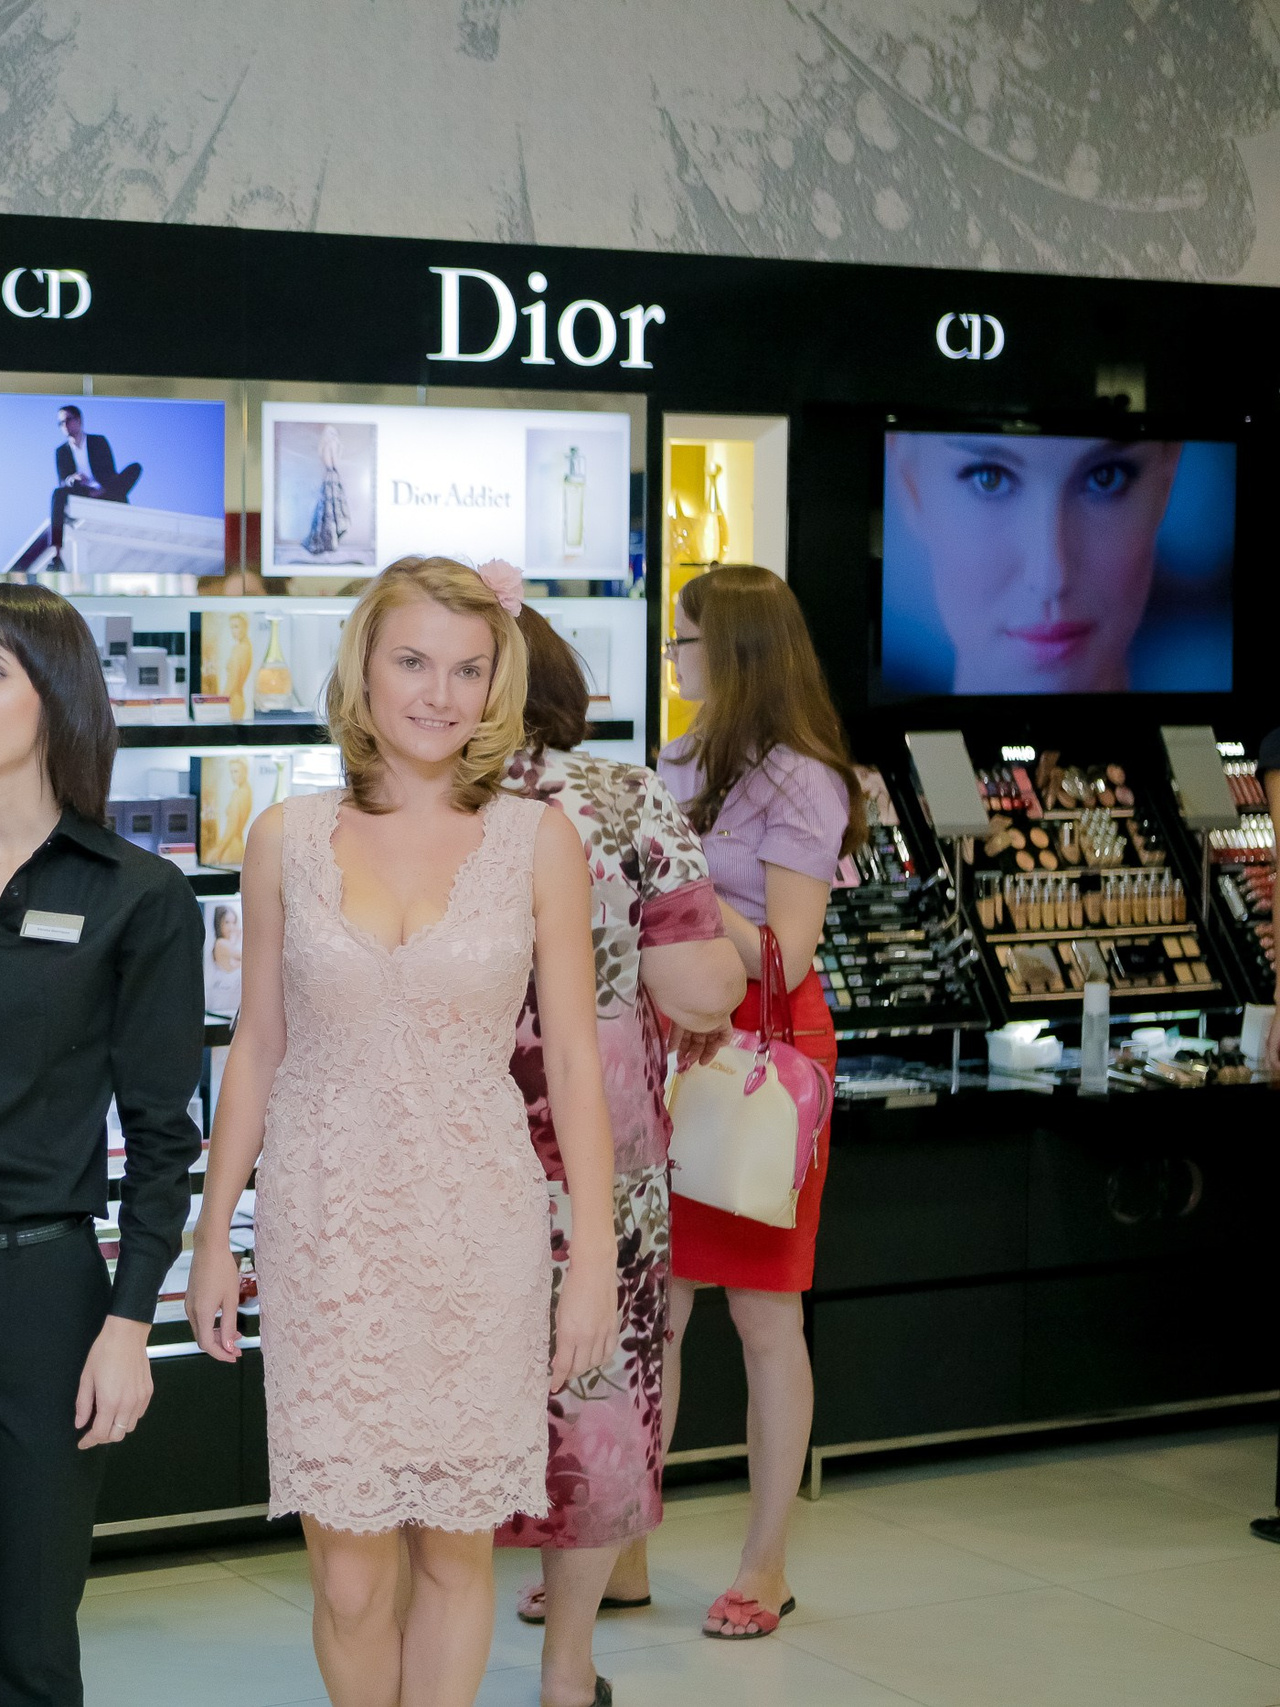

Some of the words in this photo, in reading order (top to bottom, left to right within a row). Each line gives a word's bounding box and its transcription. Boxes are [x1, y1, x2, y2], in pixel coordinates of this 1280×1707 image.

[1, 267, 93, 320] CD
[426, 266, 666, 370] Dior
[935, 312, 1006, 361] CD
[391, 479, 441, 506] Dior
[444, 482, 512, 508] Addict
